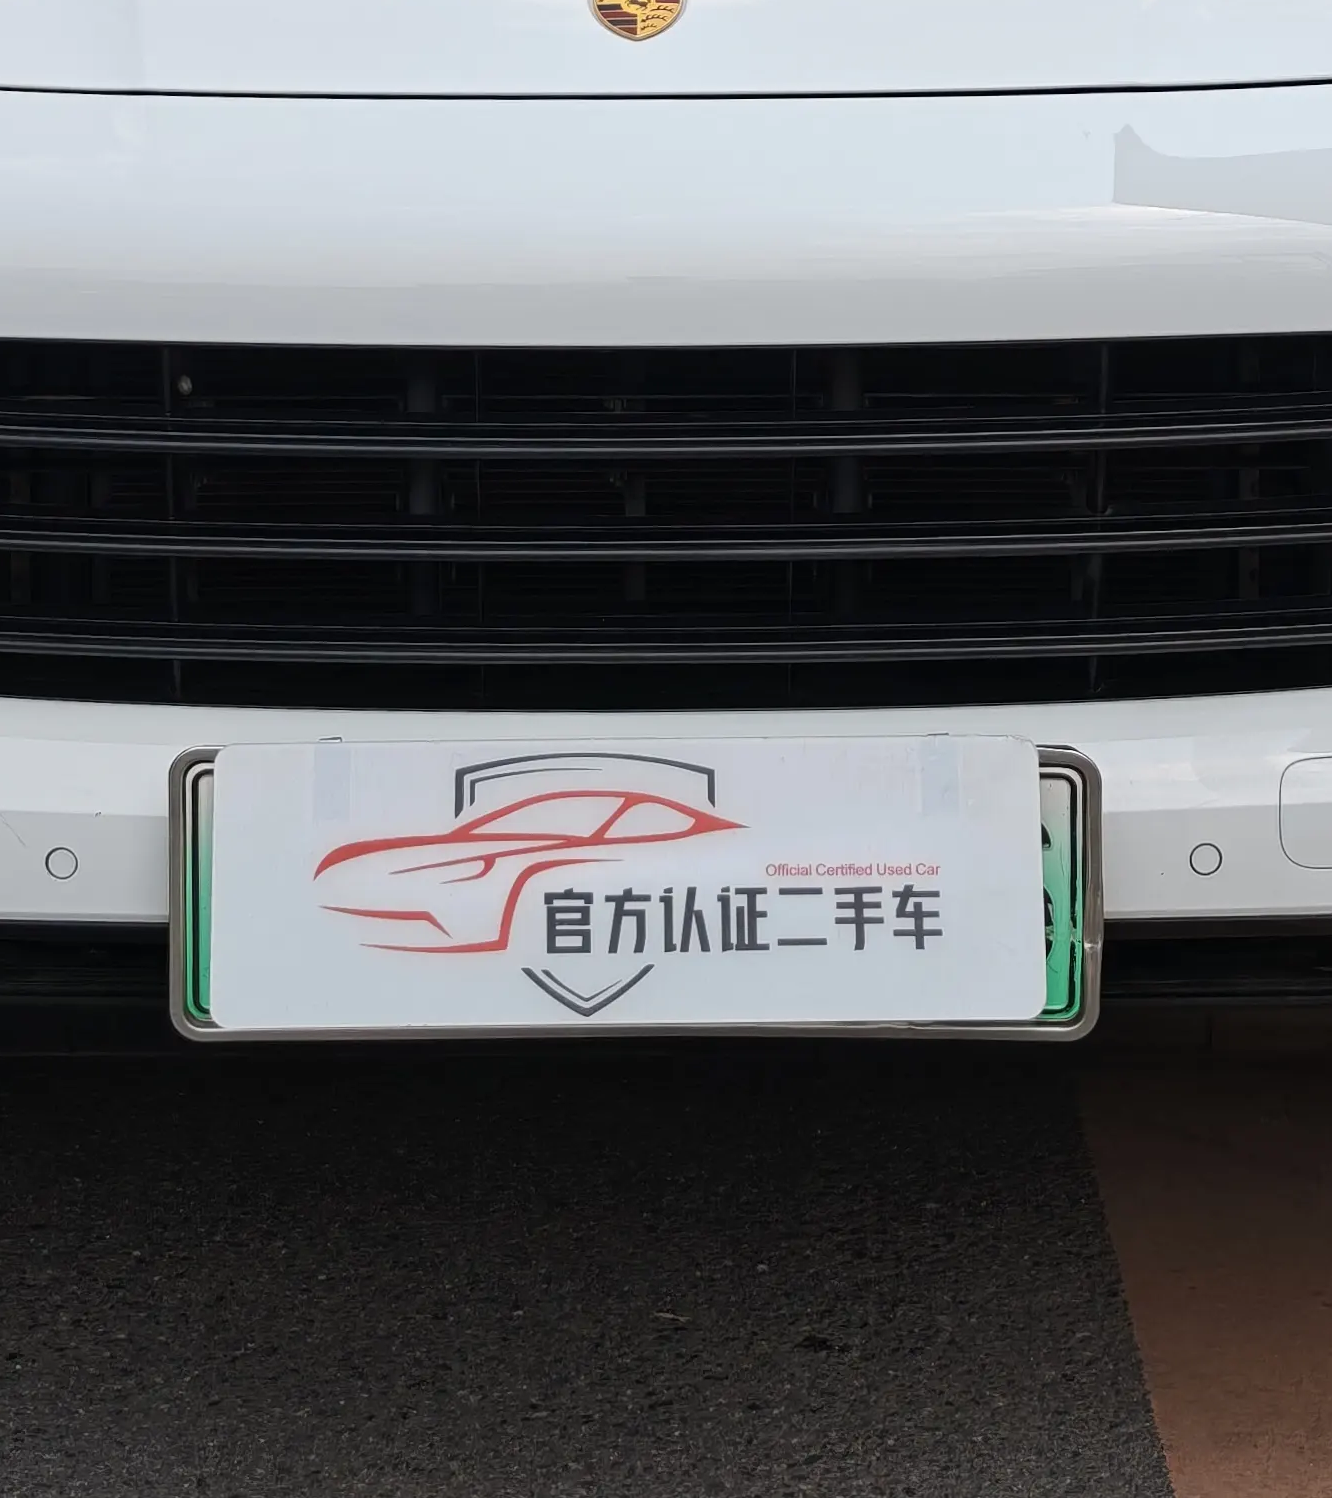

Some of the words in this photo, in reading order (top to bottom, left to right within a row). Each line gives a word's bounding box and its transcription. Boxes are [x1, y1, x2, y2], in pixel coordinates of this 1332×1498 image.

[765, 862, 812, 877] Official
[815, 862, 872, 877] Certified
[876, 862, 912, 877] Used
[916, 862, 941, 877] Car
[543, 883, 944, 954] 官方认证二手车
